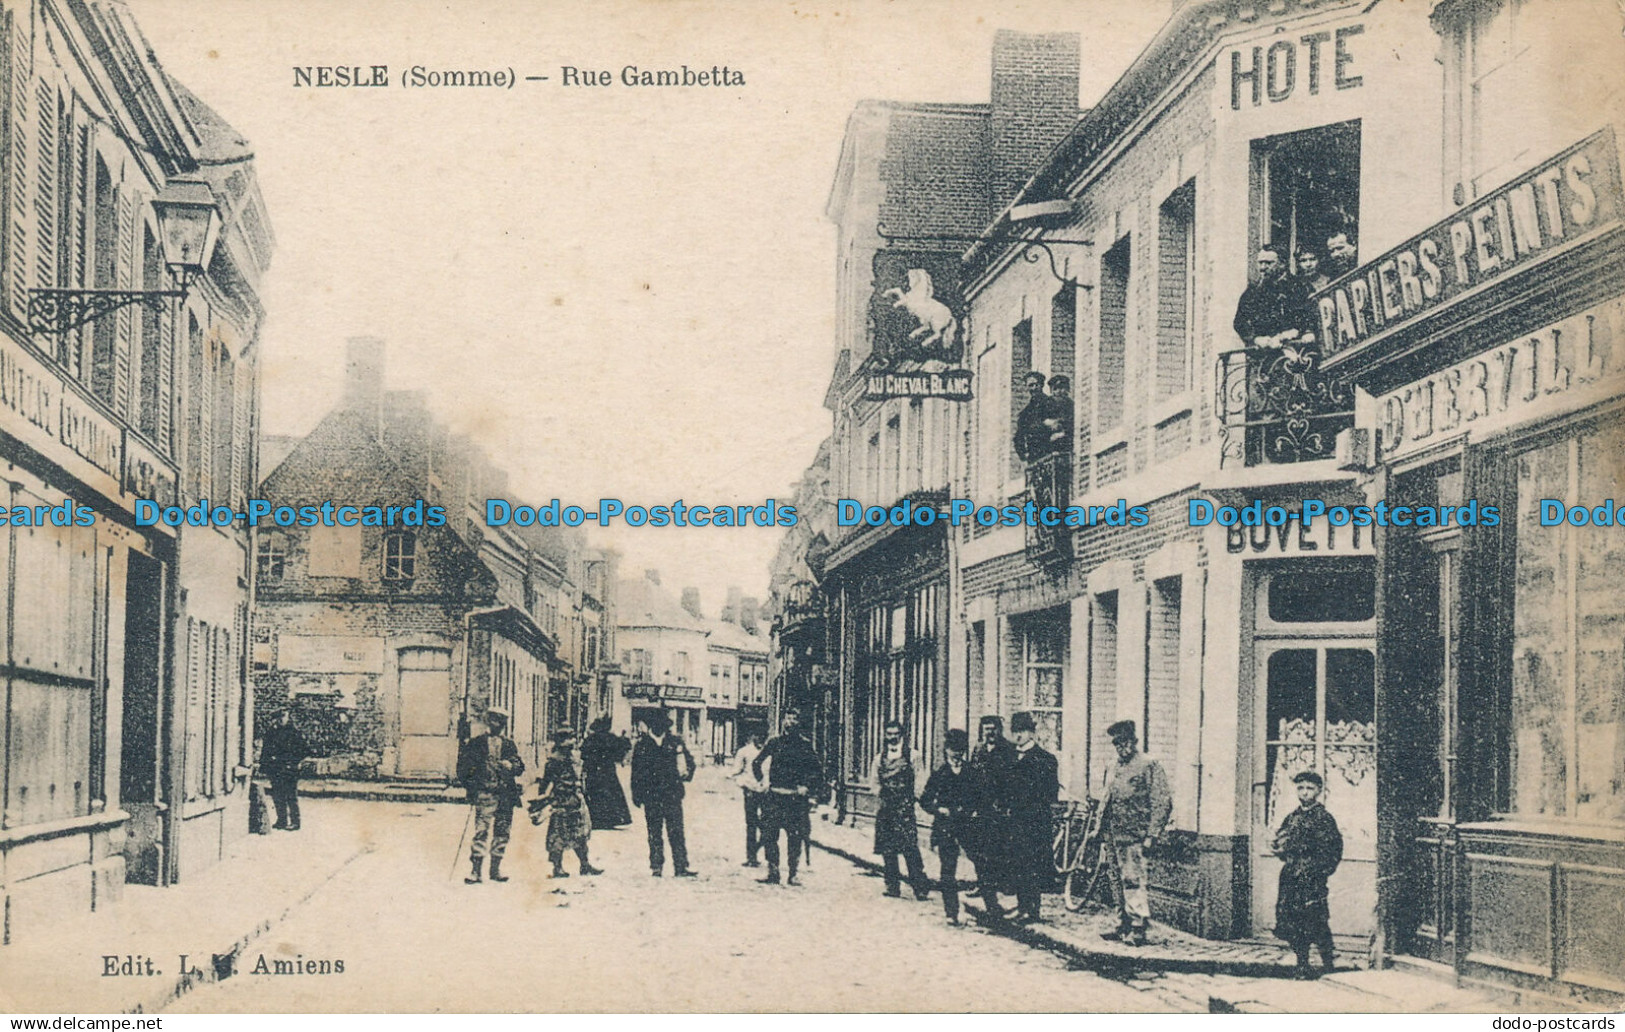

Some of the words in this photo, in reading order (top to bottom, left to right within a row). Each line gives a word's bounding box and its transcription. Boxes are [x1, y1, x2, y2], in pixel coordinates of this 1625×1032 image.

[1317, 238, 1443, 358] PAPIERS
[1449, 153, 1597, 285] PEINTS
[868, 376, 884, 395] AU
[885, 373, 930, 395] CHEVAL
[930, 373, 969, 395] BLANC
